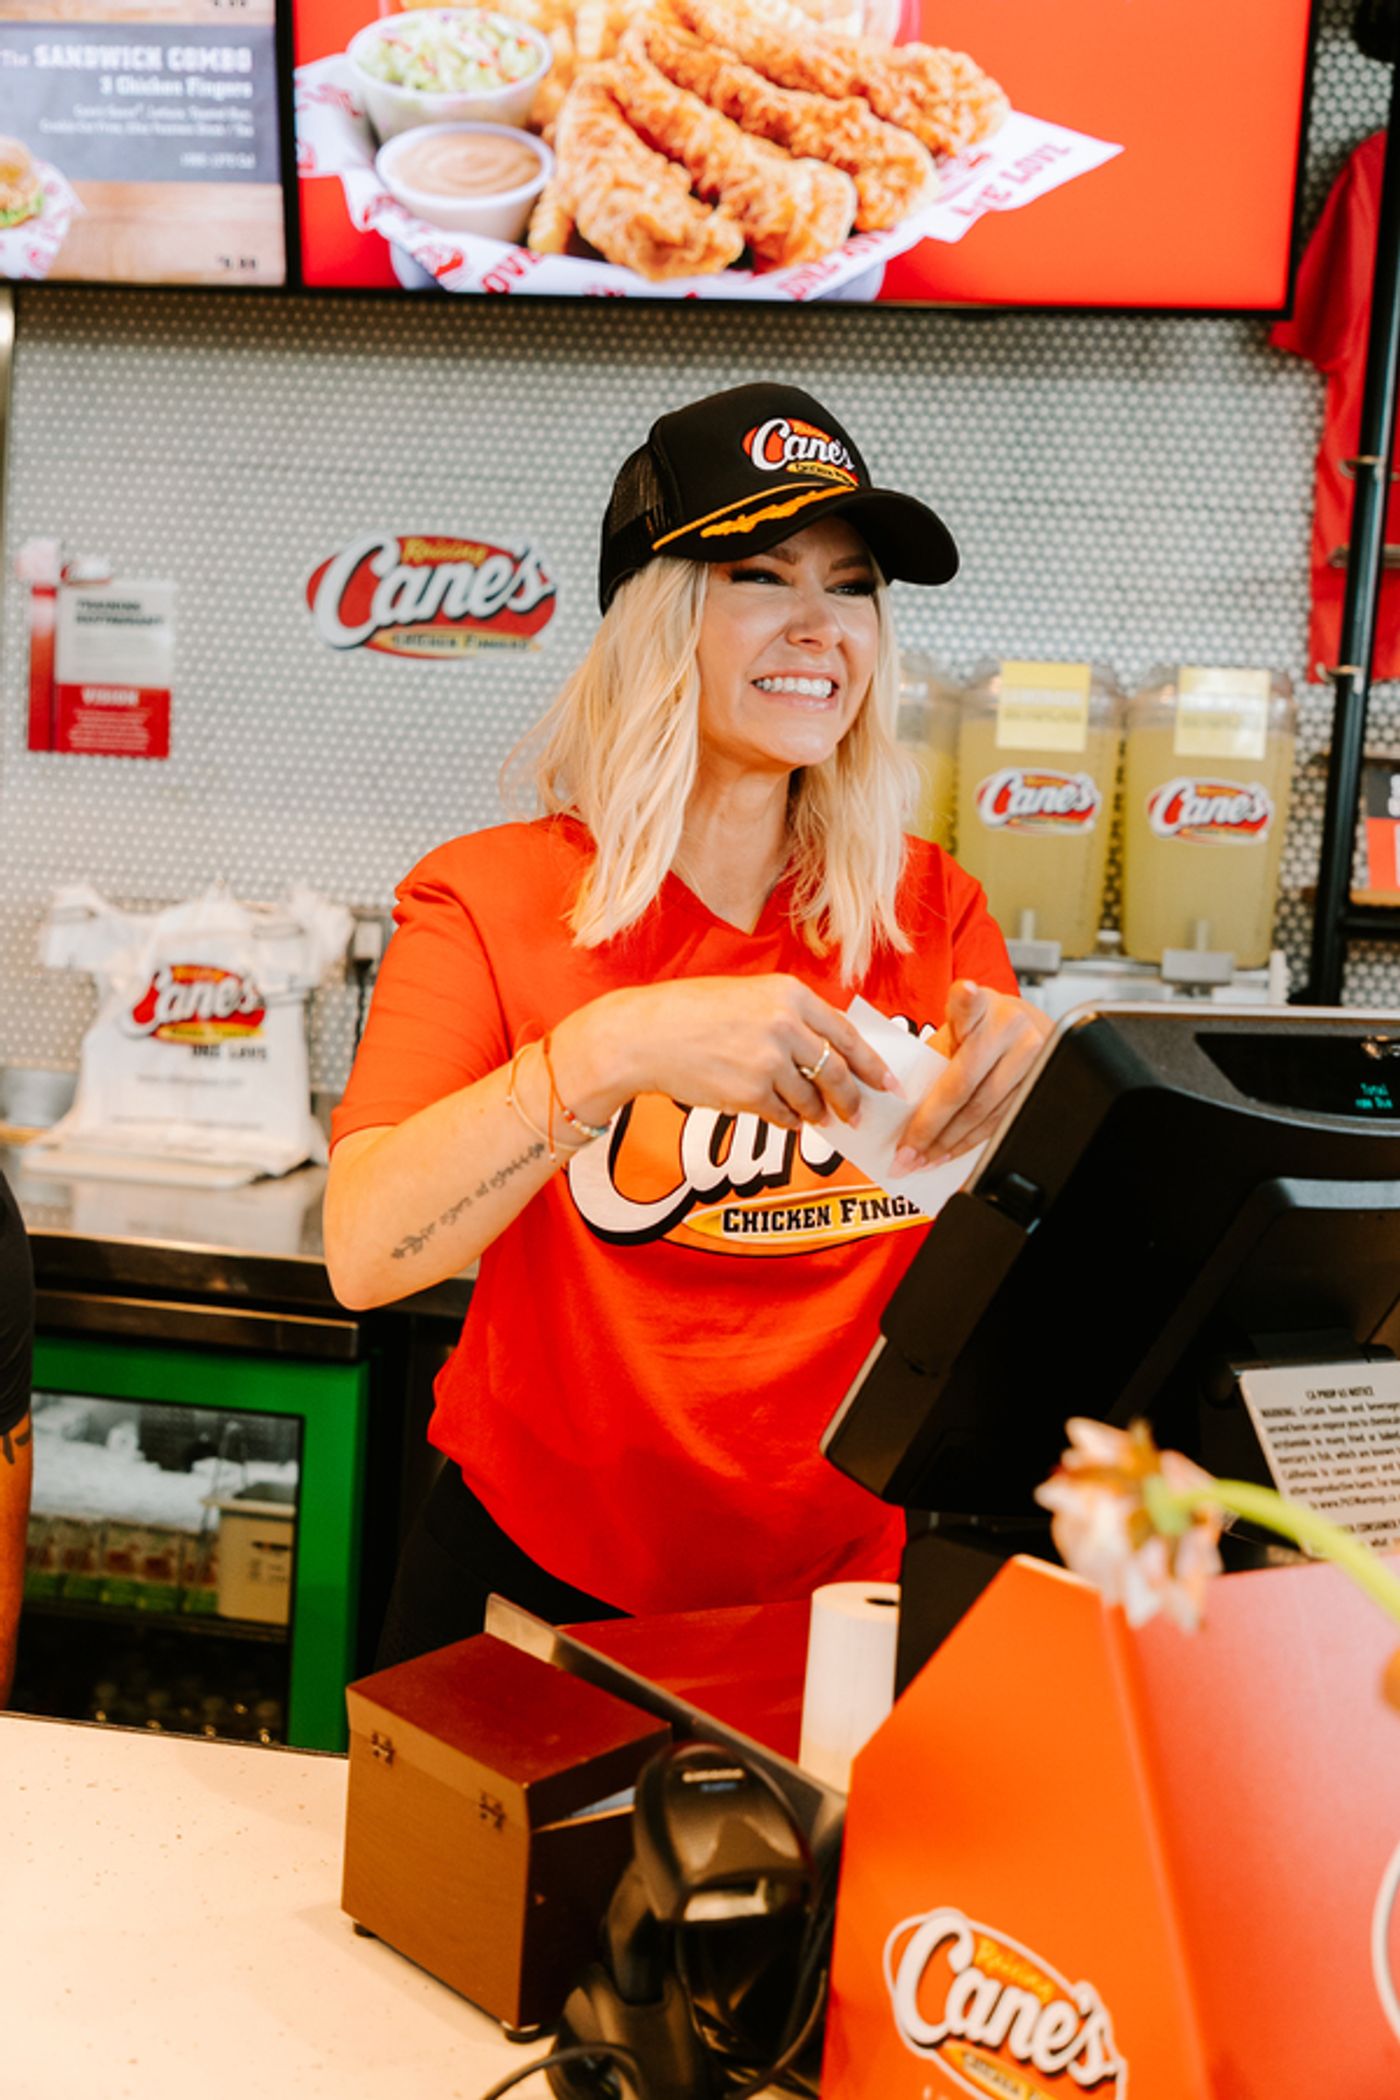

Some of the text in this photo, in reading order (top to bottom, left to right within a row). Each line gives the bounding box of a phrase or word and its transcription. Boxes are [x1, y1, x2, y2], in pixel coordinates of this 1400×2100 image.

[34, 45, 163, 71] SANDWICH
[167, 47, 253, 73] COMBO
[751, 417, 855, 471] Cane's
[313, 532, 557, 651] Cane's
[979, 768, 1101, 829] Cane's
[1149, 775, 1271, 838] Cane's
[722, 1194, 924, 1234] CHICKEN FINGE
[894, 1912, 1119, 2093] Cane's
